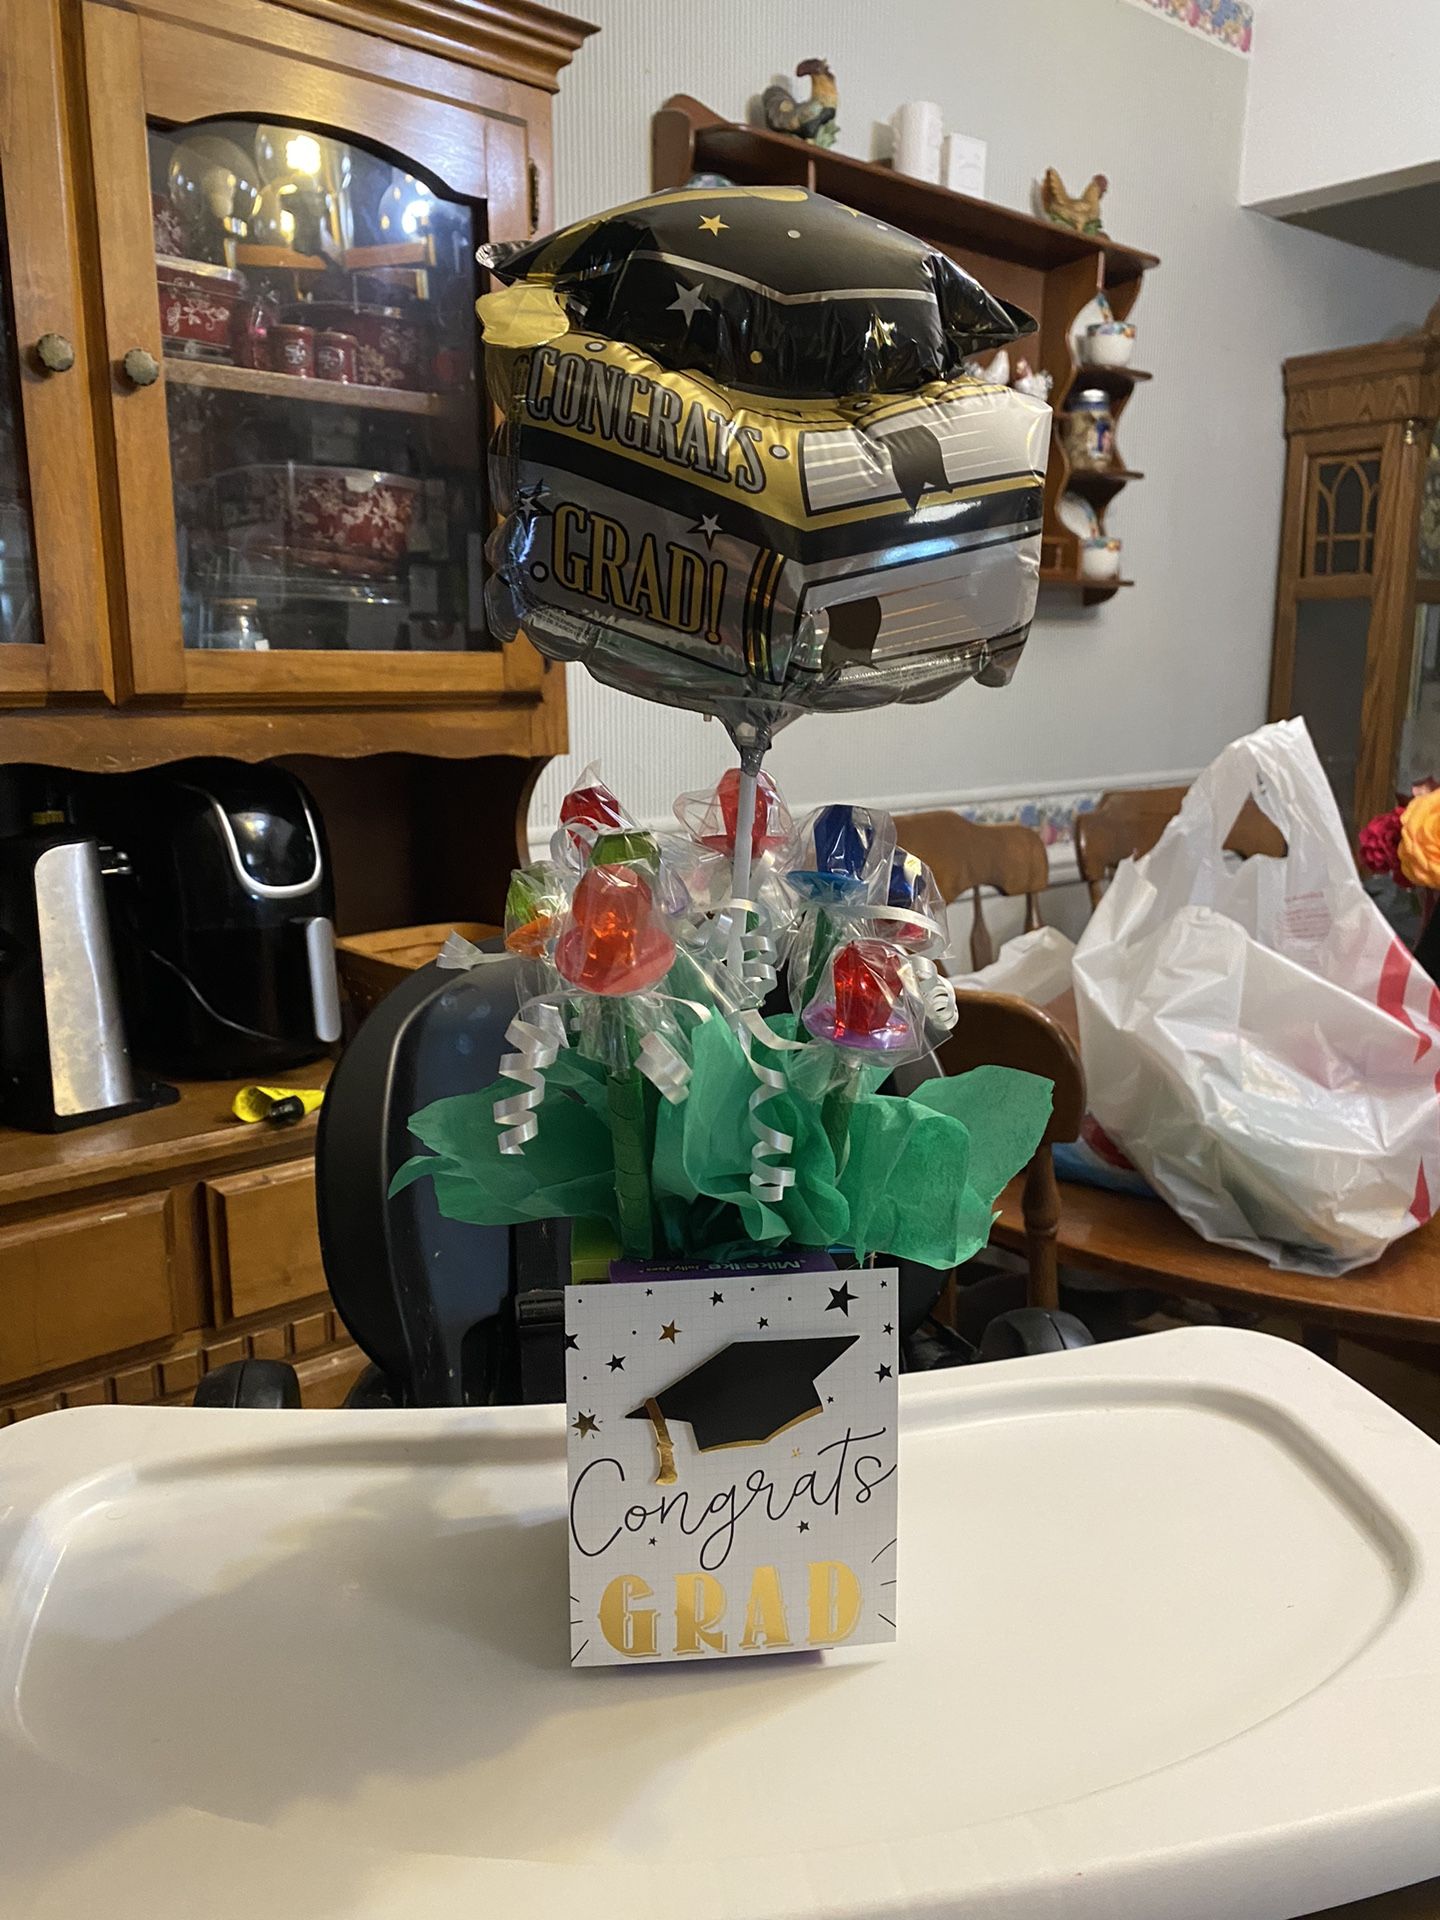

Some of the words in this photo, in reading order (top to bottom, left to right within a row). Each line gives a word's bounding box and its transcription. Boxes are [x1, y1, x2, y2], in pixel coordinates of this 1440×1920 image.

[527, 347, 767, 494] CONGRATS
[552, 502, 728, 645] GRAD!
[570, 1427, 897, 1570] Congrats
[597, 1560, 864, 1658] GRAD
